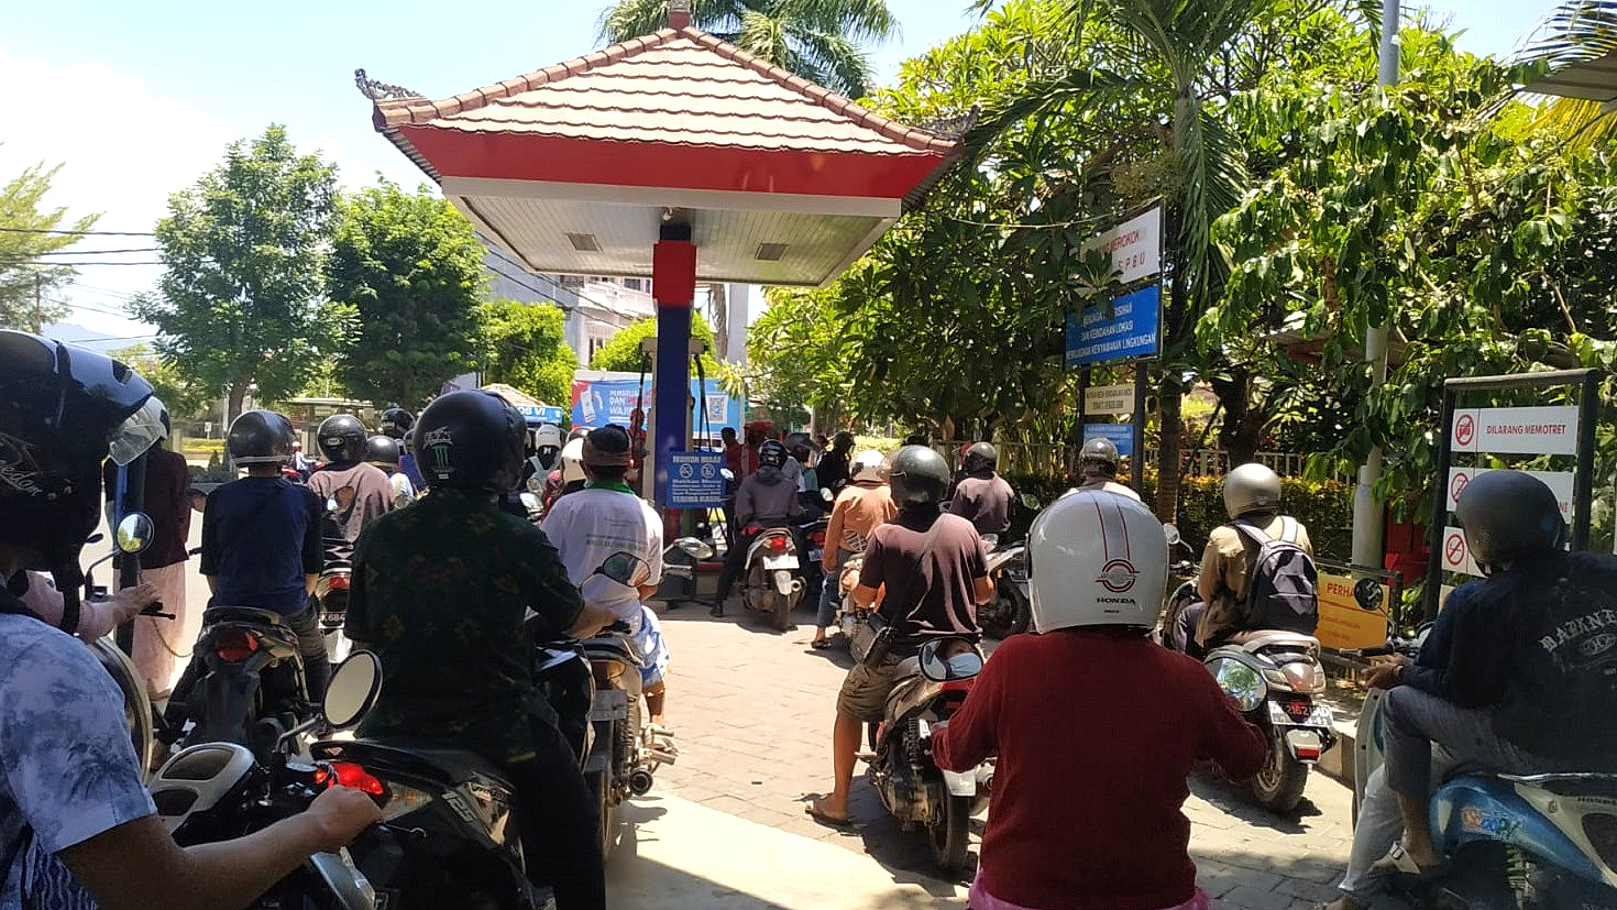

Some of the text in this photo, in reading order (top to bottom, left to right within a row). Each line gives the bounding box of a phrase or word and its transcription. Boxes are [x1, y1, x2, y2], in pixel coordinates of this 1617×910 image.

[1122, 332, 1156, 349] LINGKUNGAN
[1486, 423, 1567, 435] DILARANG MEMOTRET
[1096, 598, 1137, 606] HONDA
[441, 791, 477, 821] 125
